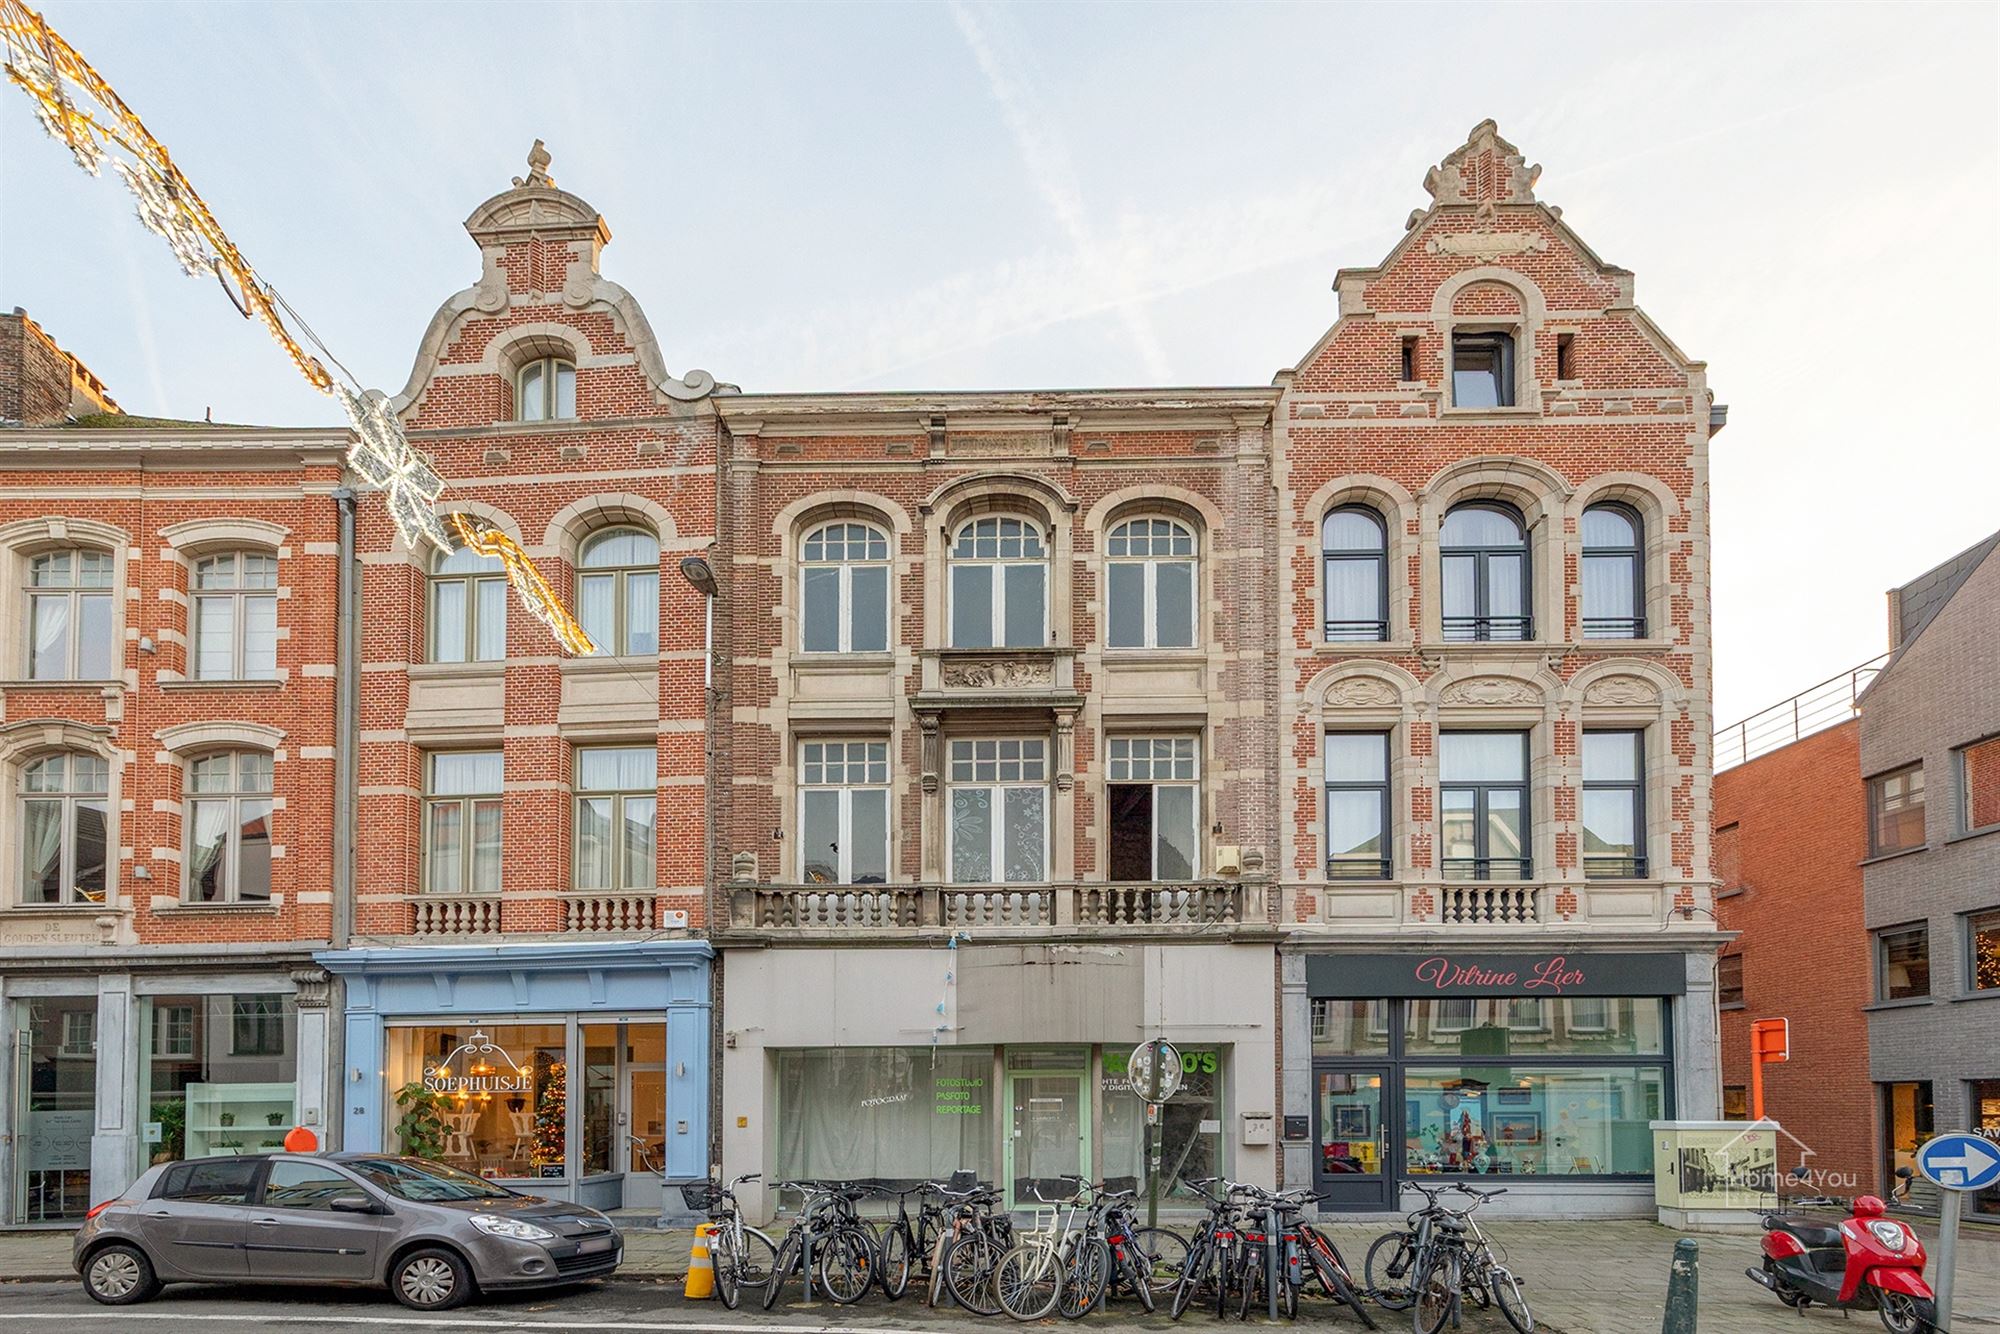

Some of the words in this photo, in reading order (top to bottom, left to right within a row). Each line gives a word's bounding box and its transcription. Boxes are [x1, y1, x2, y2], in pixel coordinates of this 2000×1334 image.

[44, 922, 60, 932] DE
[51, 933, 99, 944] SLEUTEL
[1416, 957, 1518, 989] Vitrine
[1523, 956, 1586, 995] Lier
[424, 1075, 533, 1091] SOEPHUISJE
[935, 1079, 983, 1087] FOTOSTUDIO
[935, 1091, 971, 1100] PASFOTO
[353, 1107, 365, 1115] 28
[935, 1105, 982, 1114] REPORTAGE
